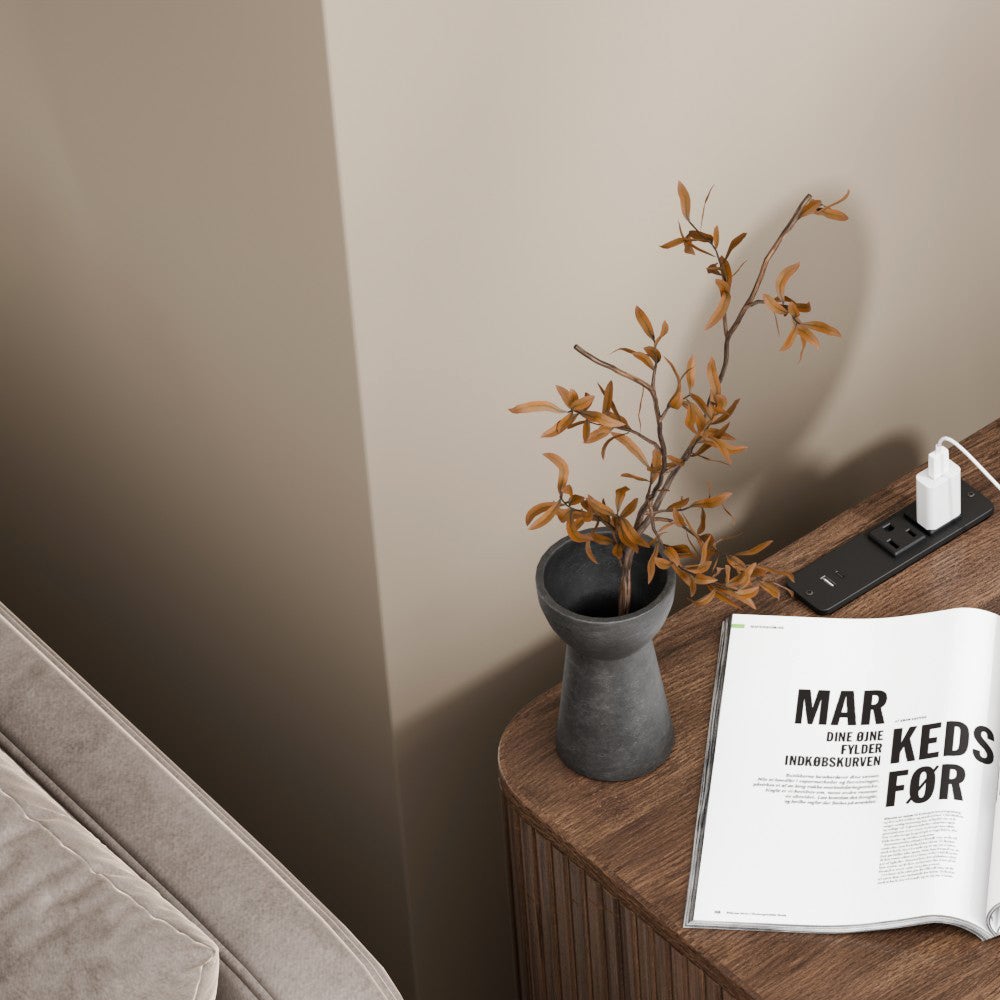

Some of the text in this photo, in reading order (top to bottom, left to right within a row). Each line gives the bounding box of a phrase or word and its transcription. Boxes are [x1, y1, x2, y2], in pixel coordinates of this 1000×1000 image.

[795, 690, 887, 725] MAR
[827, 730, 884, 742] DINE ØJNE
[891, 722, 994, 764] KEDS
[841, 743, 882, 755] FYLDER
[785, 756, 881, 768] INDKØBSKURVEN
[886, 764, 966, 807] FØR
